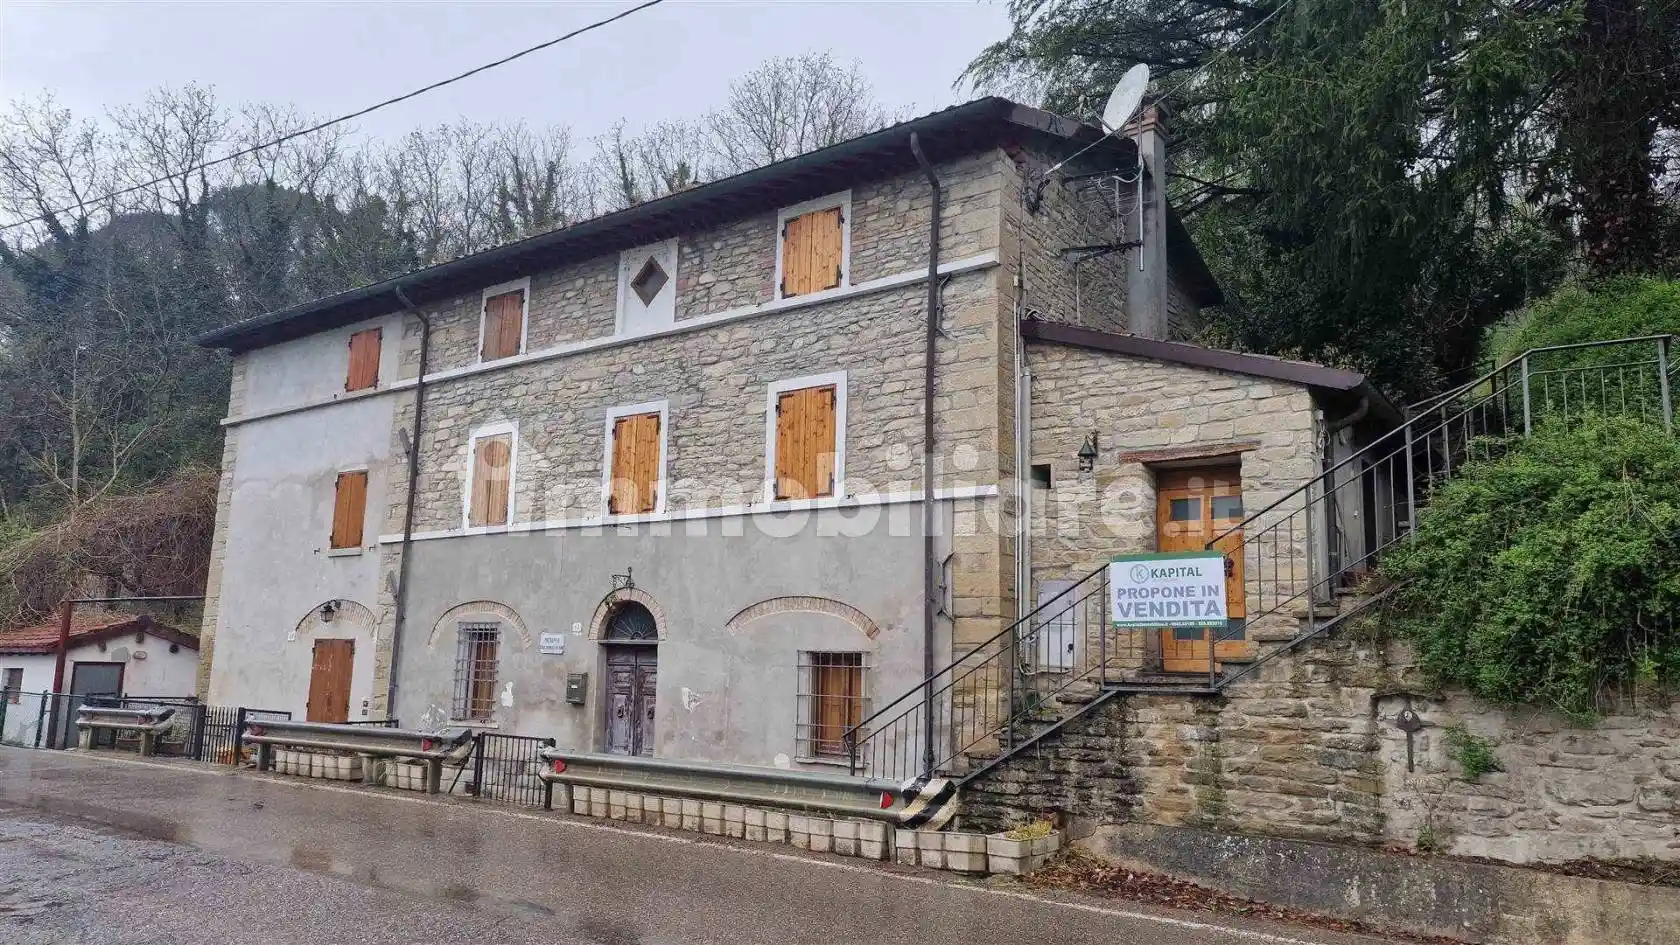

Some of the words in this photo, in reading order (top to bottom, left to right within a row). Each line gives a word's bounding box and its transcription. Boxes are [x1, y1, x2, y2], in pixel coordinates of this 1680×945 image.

[1151, 567, 1203, 578] KAPITAL
[1117, 586, 1195, 600] PROPONE
[1201, 585, 1219, 597] IN
[1117, 600, 1221, 618] VENDITA
